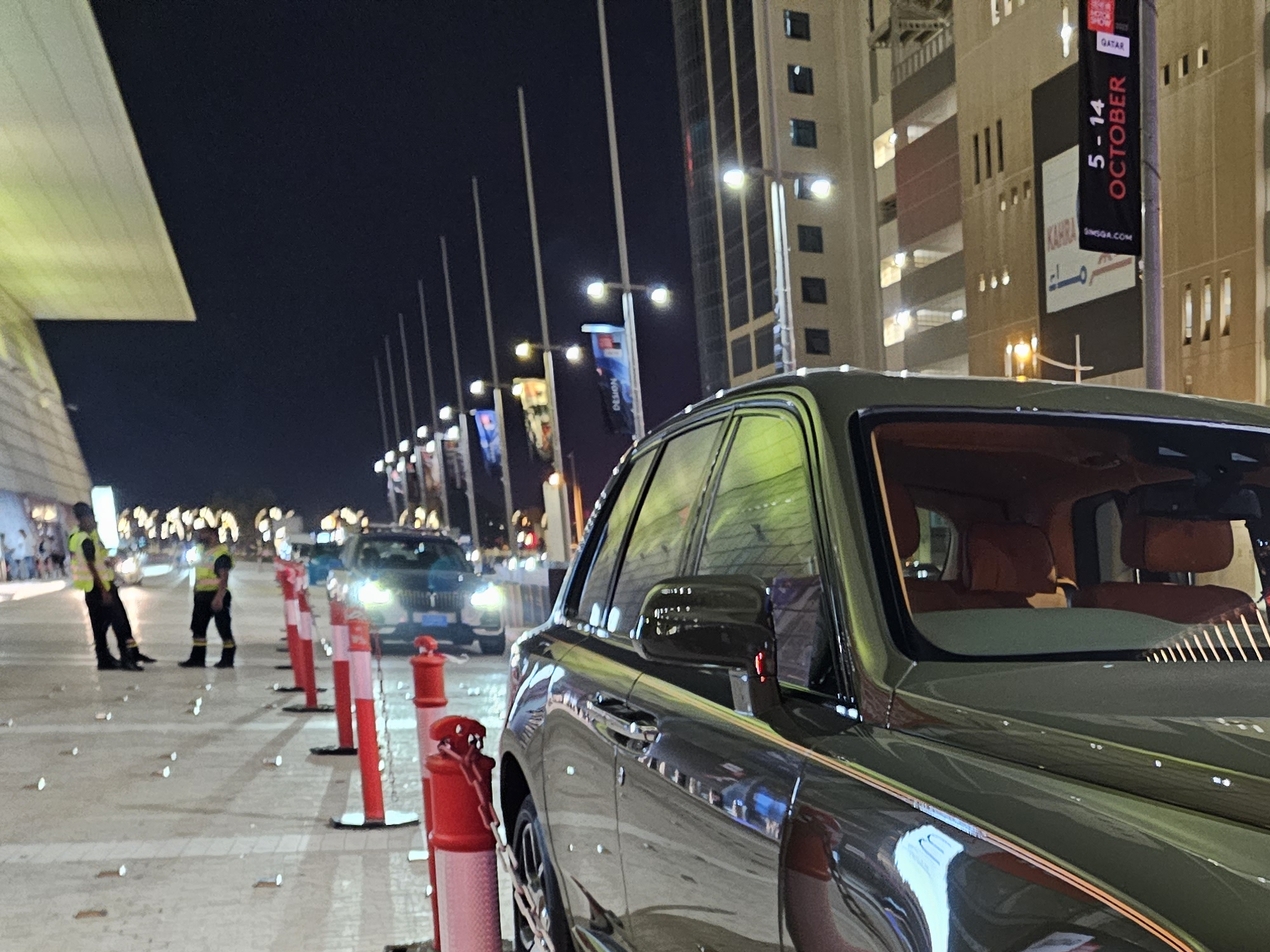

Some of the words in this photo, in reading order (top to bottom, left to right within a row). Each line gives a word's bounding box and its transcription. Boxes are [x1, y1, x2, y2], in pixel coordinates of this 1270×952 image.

[1101, 38, 1124, 51] QATAR
[1089, 99, 1105, 126] 14
[1109, 76, 1126, 200] OCTOBER
[1088, 154, 1105, 169] 5
[1047, 217, 1077, 252] KAHRA
